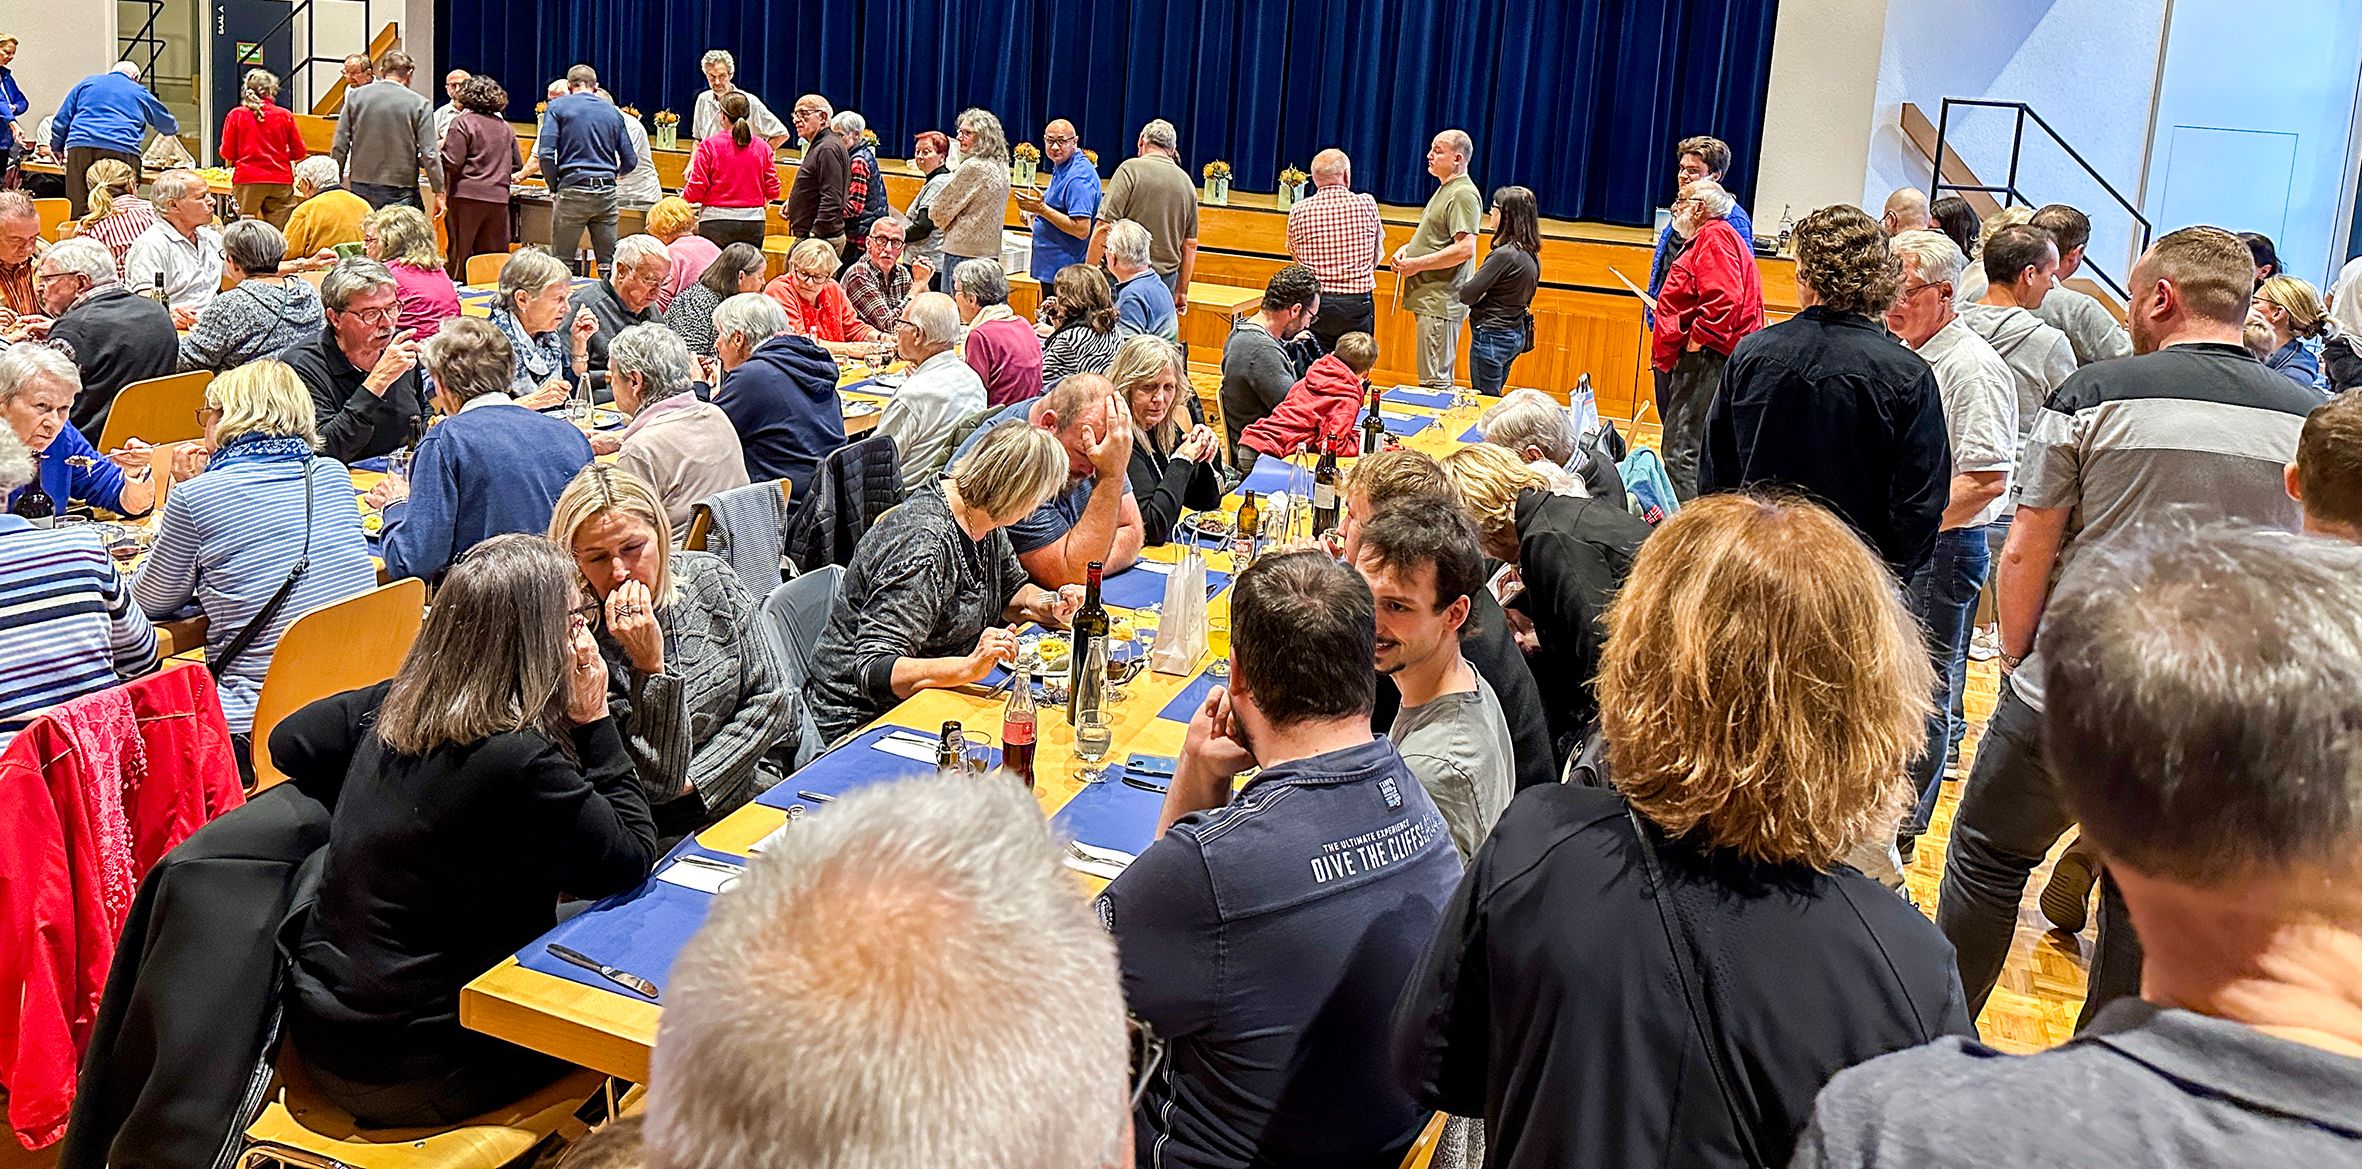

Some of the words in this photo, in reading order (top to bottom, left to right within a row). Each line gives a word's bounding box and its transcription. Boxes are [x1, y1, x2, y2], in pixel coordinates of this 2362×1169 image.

[217, 14, 225, 35] SAAL
[1322, 842, 1340, 853] THE
[1340, 832, 1376, 850] ULTIMATE
[1376, 818, 1411, 840] EXPERIENCE
[1310, 851, 1357, 884] DIVE
[1356, 842, 1389, 871] THE
